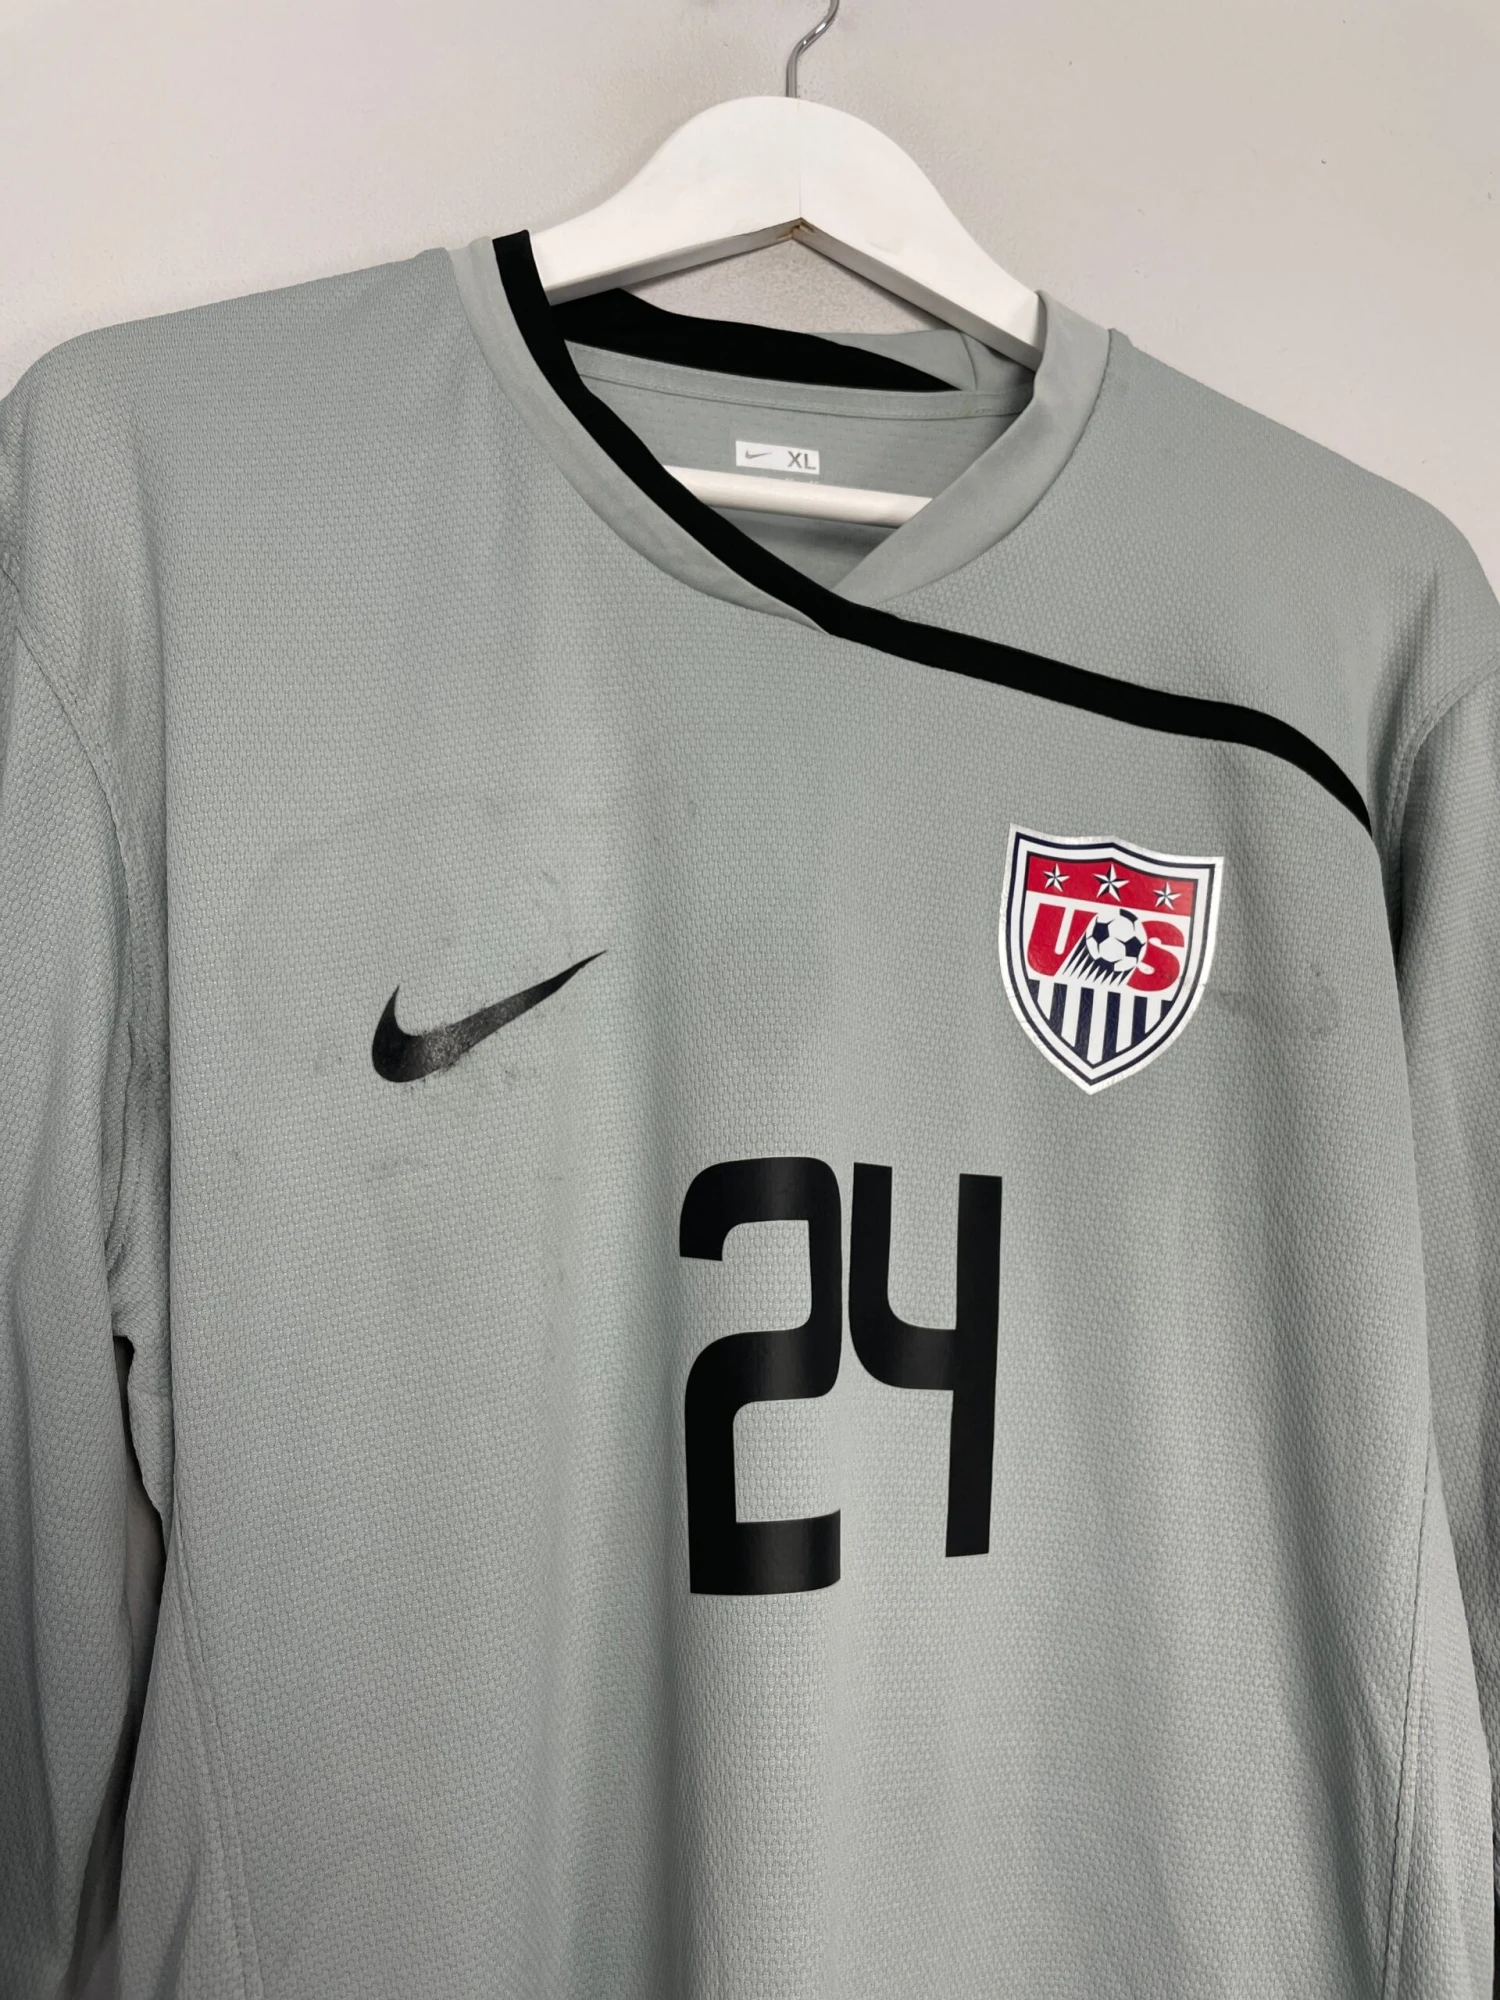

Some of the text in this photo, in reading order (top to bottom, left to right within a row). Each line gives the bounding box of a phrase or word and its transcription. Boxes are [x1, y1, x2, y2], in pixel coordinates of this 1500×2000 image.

[787, 450, 817, 470] XL
[1027, 902, 1185, 992] US
[680, 1157, 1002, 1595] 24
